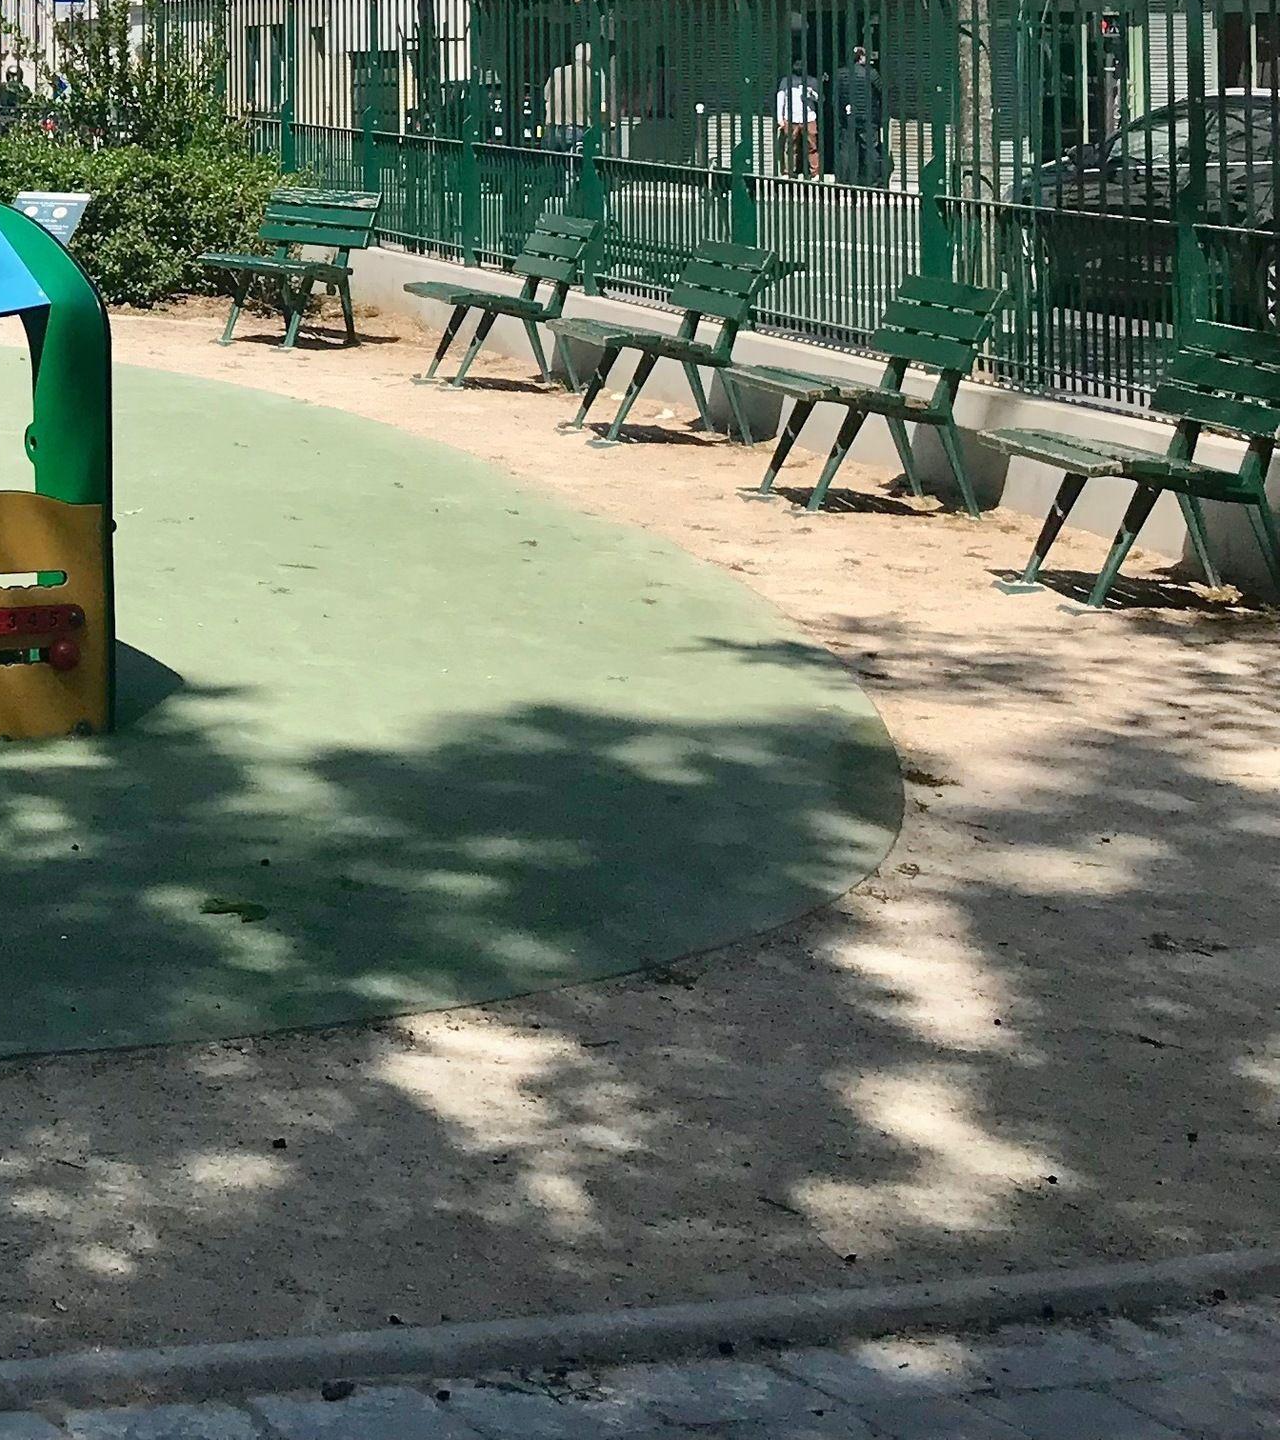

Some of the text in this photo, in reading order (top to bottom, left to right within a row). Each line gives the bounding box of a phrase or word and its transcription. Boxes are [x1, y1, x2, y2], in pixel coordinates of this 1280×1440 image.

[7, 614, 17, 630] 3
[28, 613, 37, 627] 4
[48, 612, 58, 627] 5
